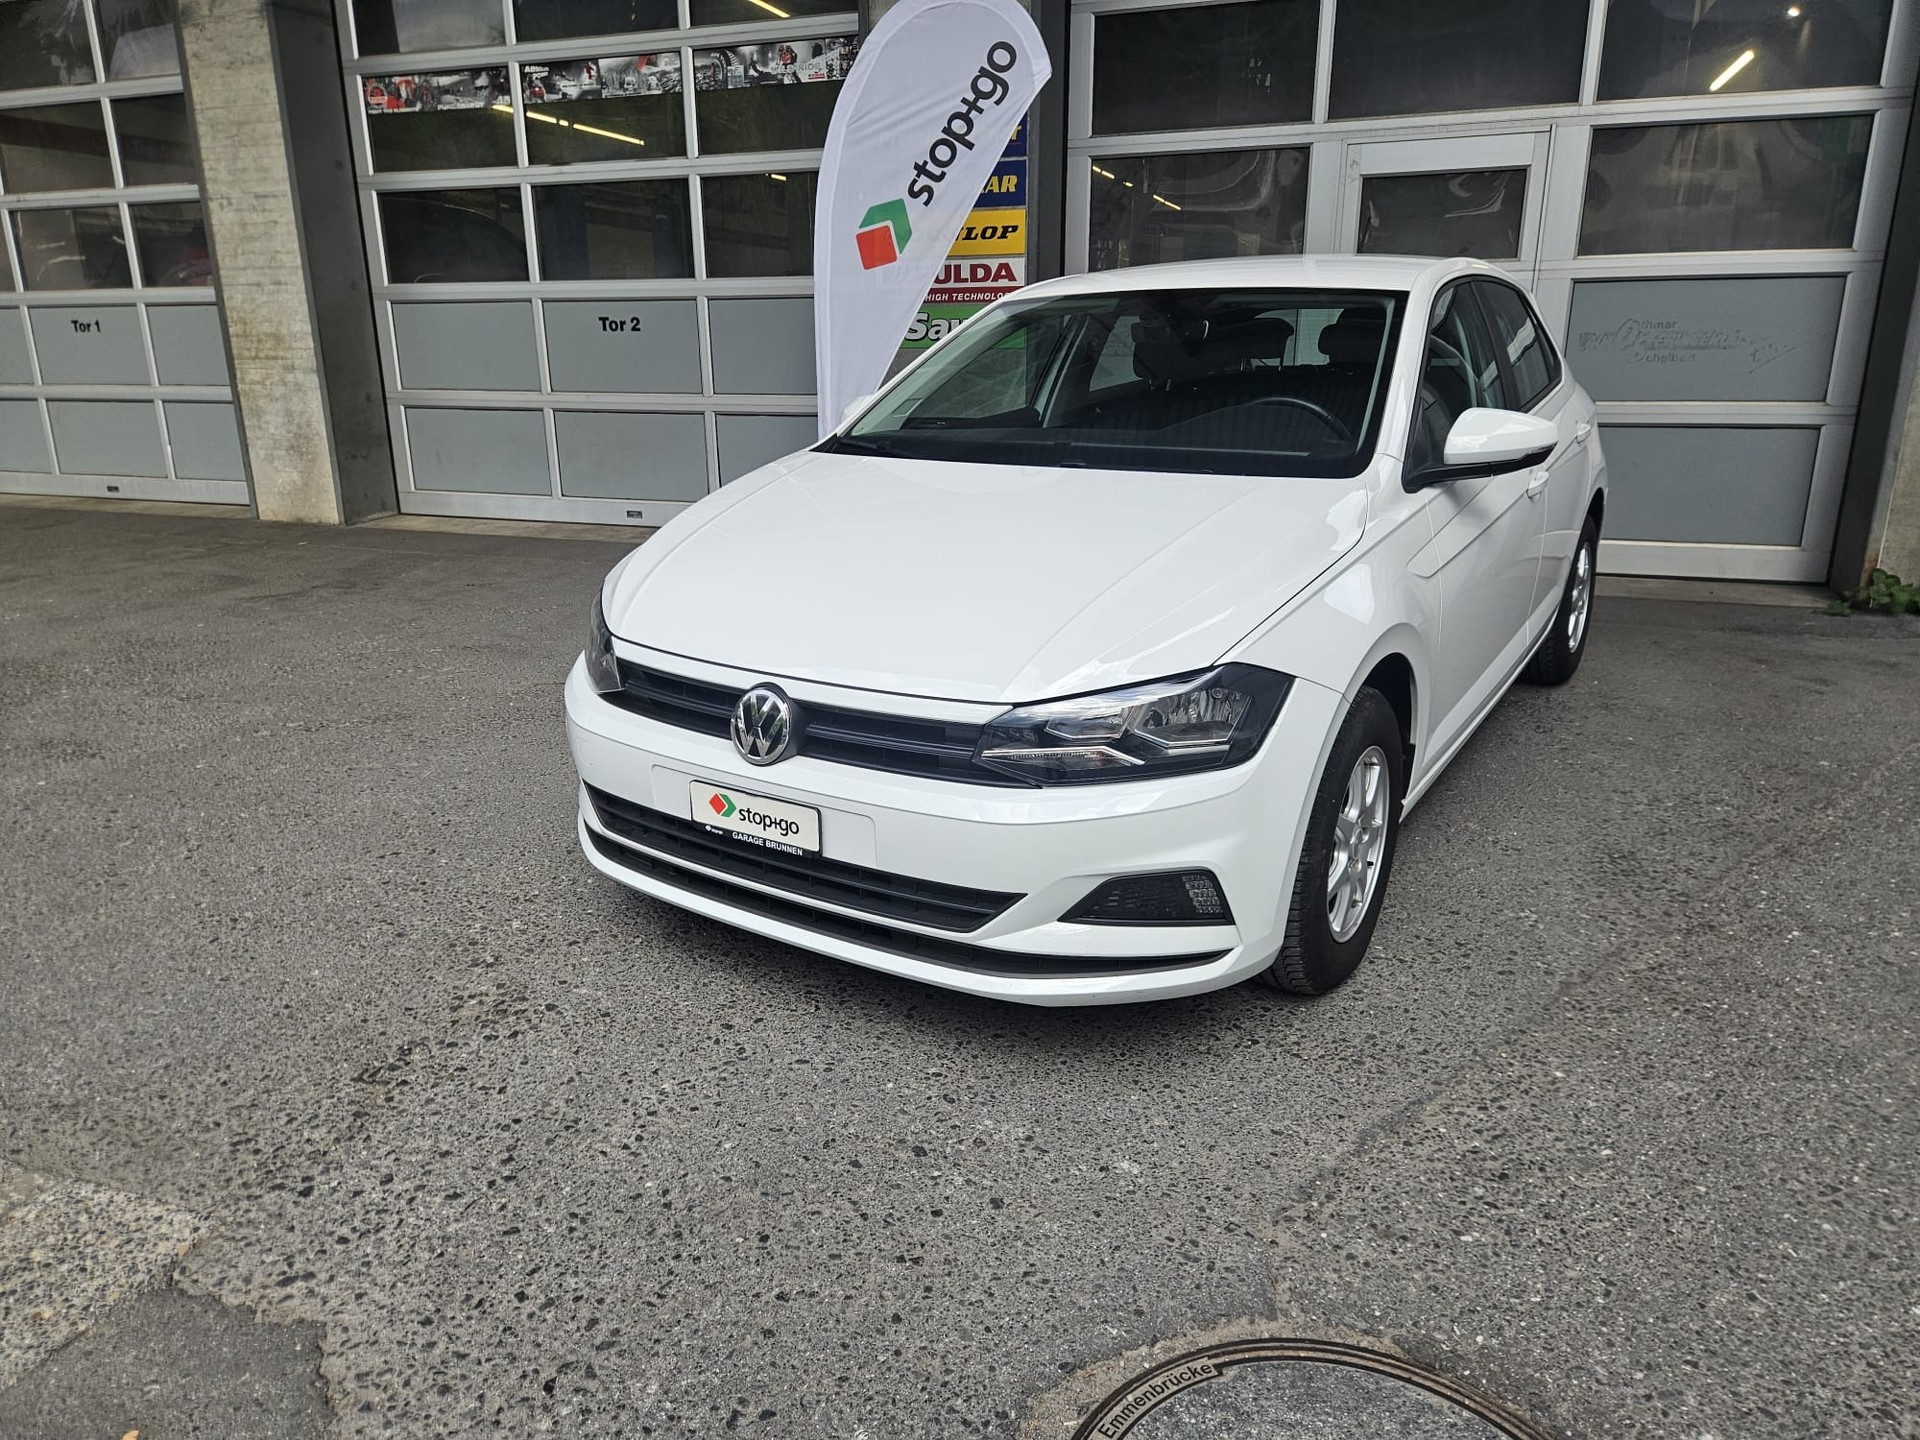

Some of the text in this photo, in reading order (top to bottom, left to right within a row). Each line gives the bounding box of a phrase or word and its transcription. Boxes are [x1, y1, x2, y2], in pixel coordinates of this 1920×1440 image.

[908, 41, 1017, 207] stop+go
[981, 175, 1018, 193] AR
[925, 293, 949, 301] HIGH
[71, 319, 101, 333] Tor 1
[598, 316, 641, 332] Tor 2
[738, 807, 800, 836] stop+go
[732, 831, 803, 856] GARAGE BRUNNEN
[1098, 1364, 1213, 1439] Emmenbrücke
